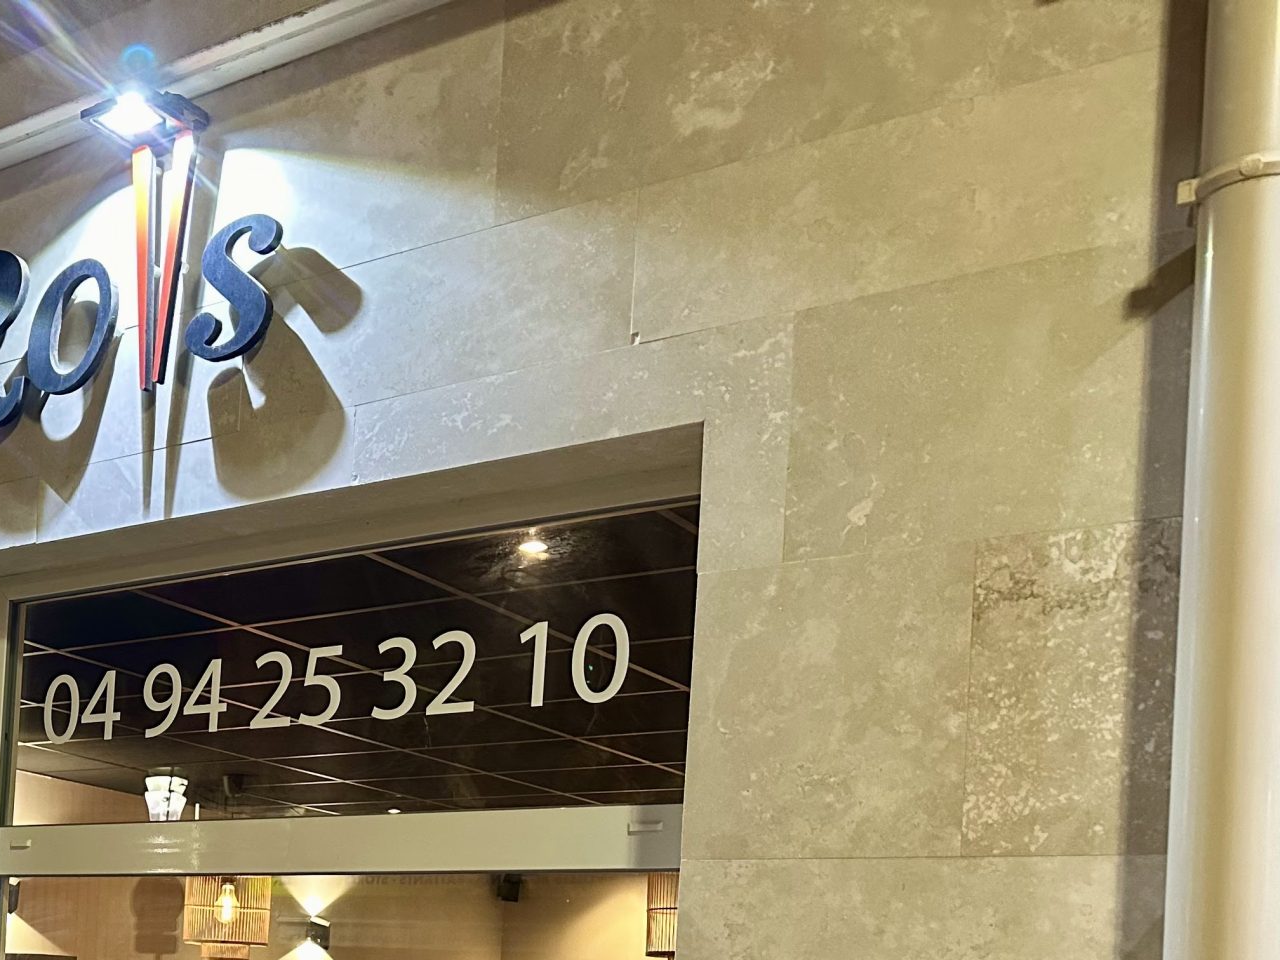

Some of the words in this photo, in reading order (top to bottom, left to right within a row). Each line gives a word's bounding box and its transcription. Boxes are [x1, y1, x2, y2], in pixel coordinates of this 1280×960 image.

[43, 669, 121, 744] 04
[143, 658, 228, 739] 94
[249, 645, 344, 730] 25
[371, 630, 477, 720] 32
[520, 613, 631, 708] 10
